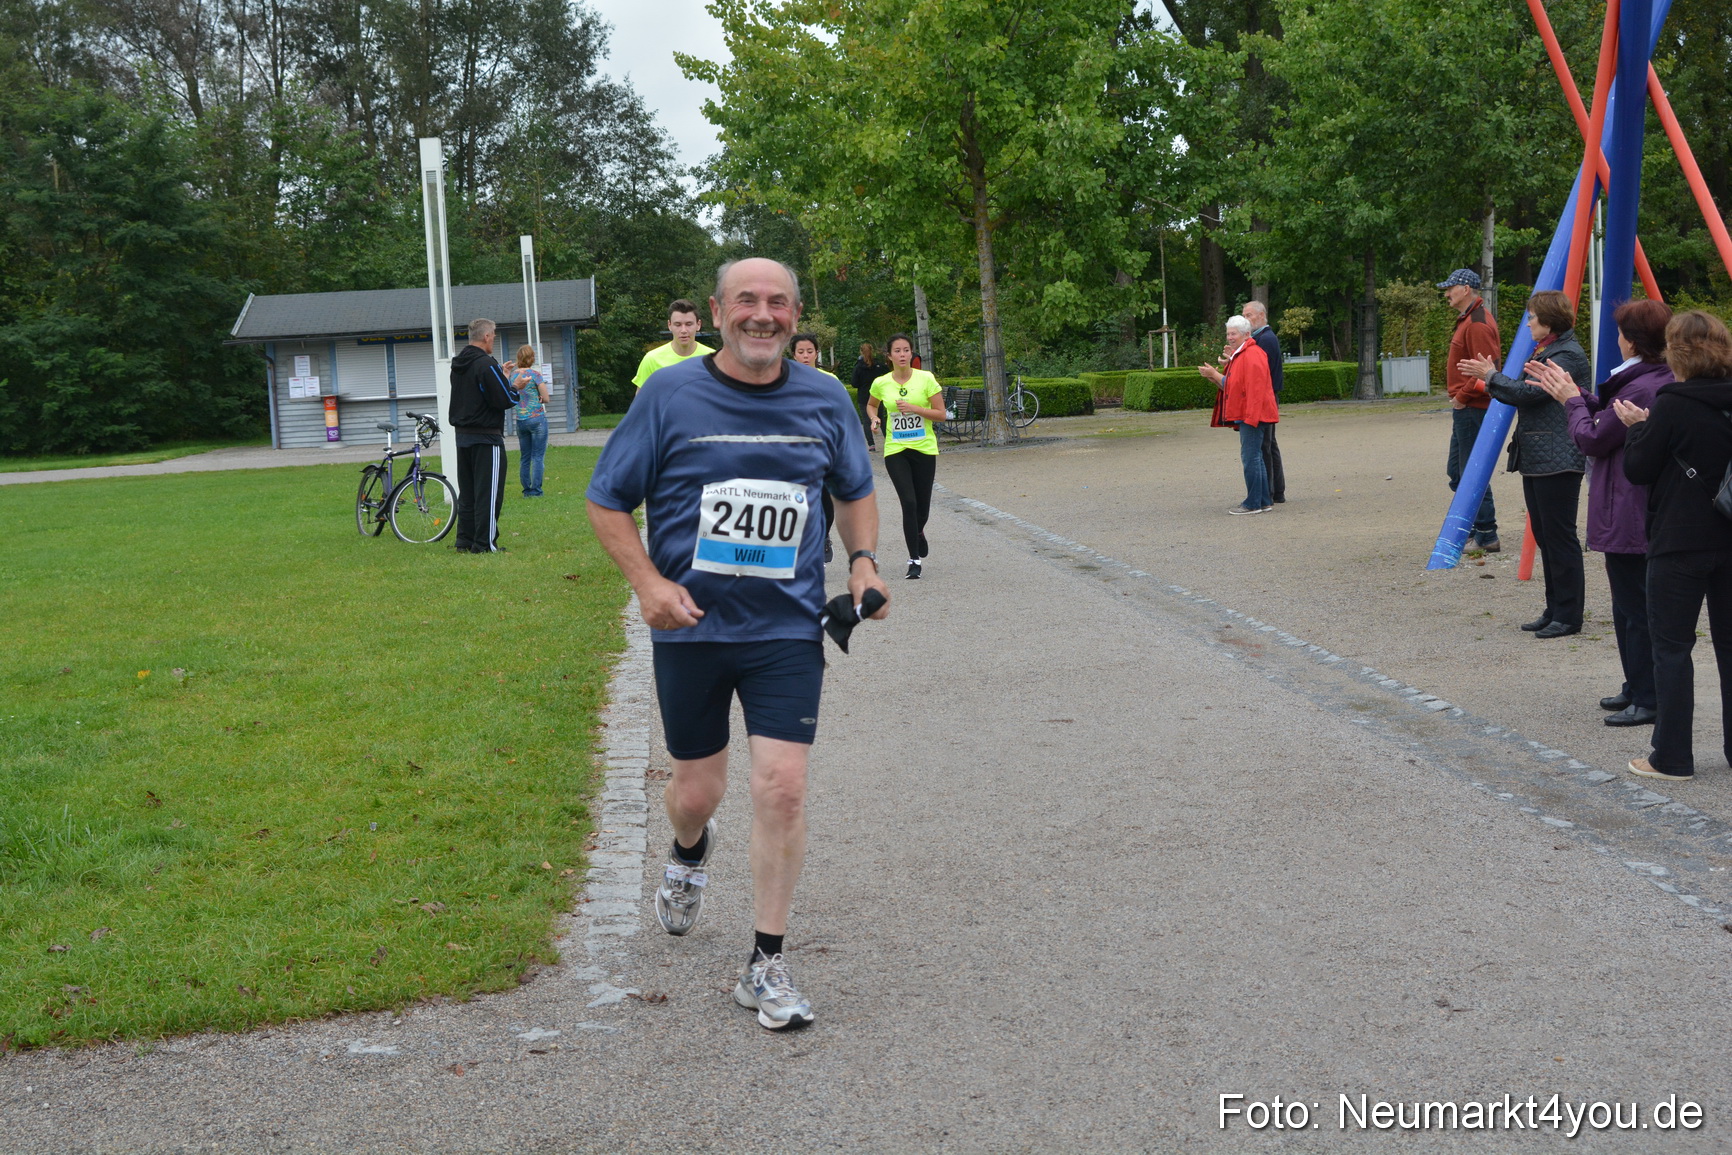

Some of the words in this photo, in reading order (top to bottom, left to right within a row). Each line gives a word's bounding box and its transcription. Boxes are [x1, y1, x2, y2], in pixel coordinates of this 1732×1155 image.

[894, 416, 922, 430] 2032
[743, 489, 791, 501] Neumarkt
[711, 501, 798, 542] 2400
[735, 547, 766, 563] Willi
